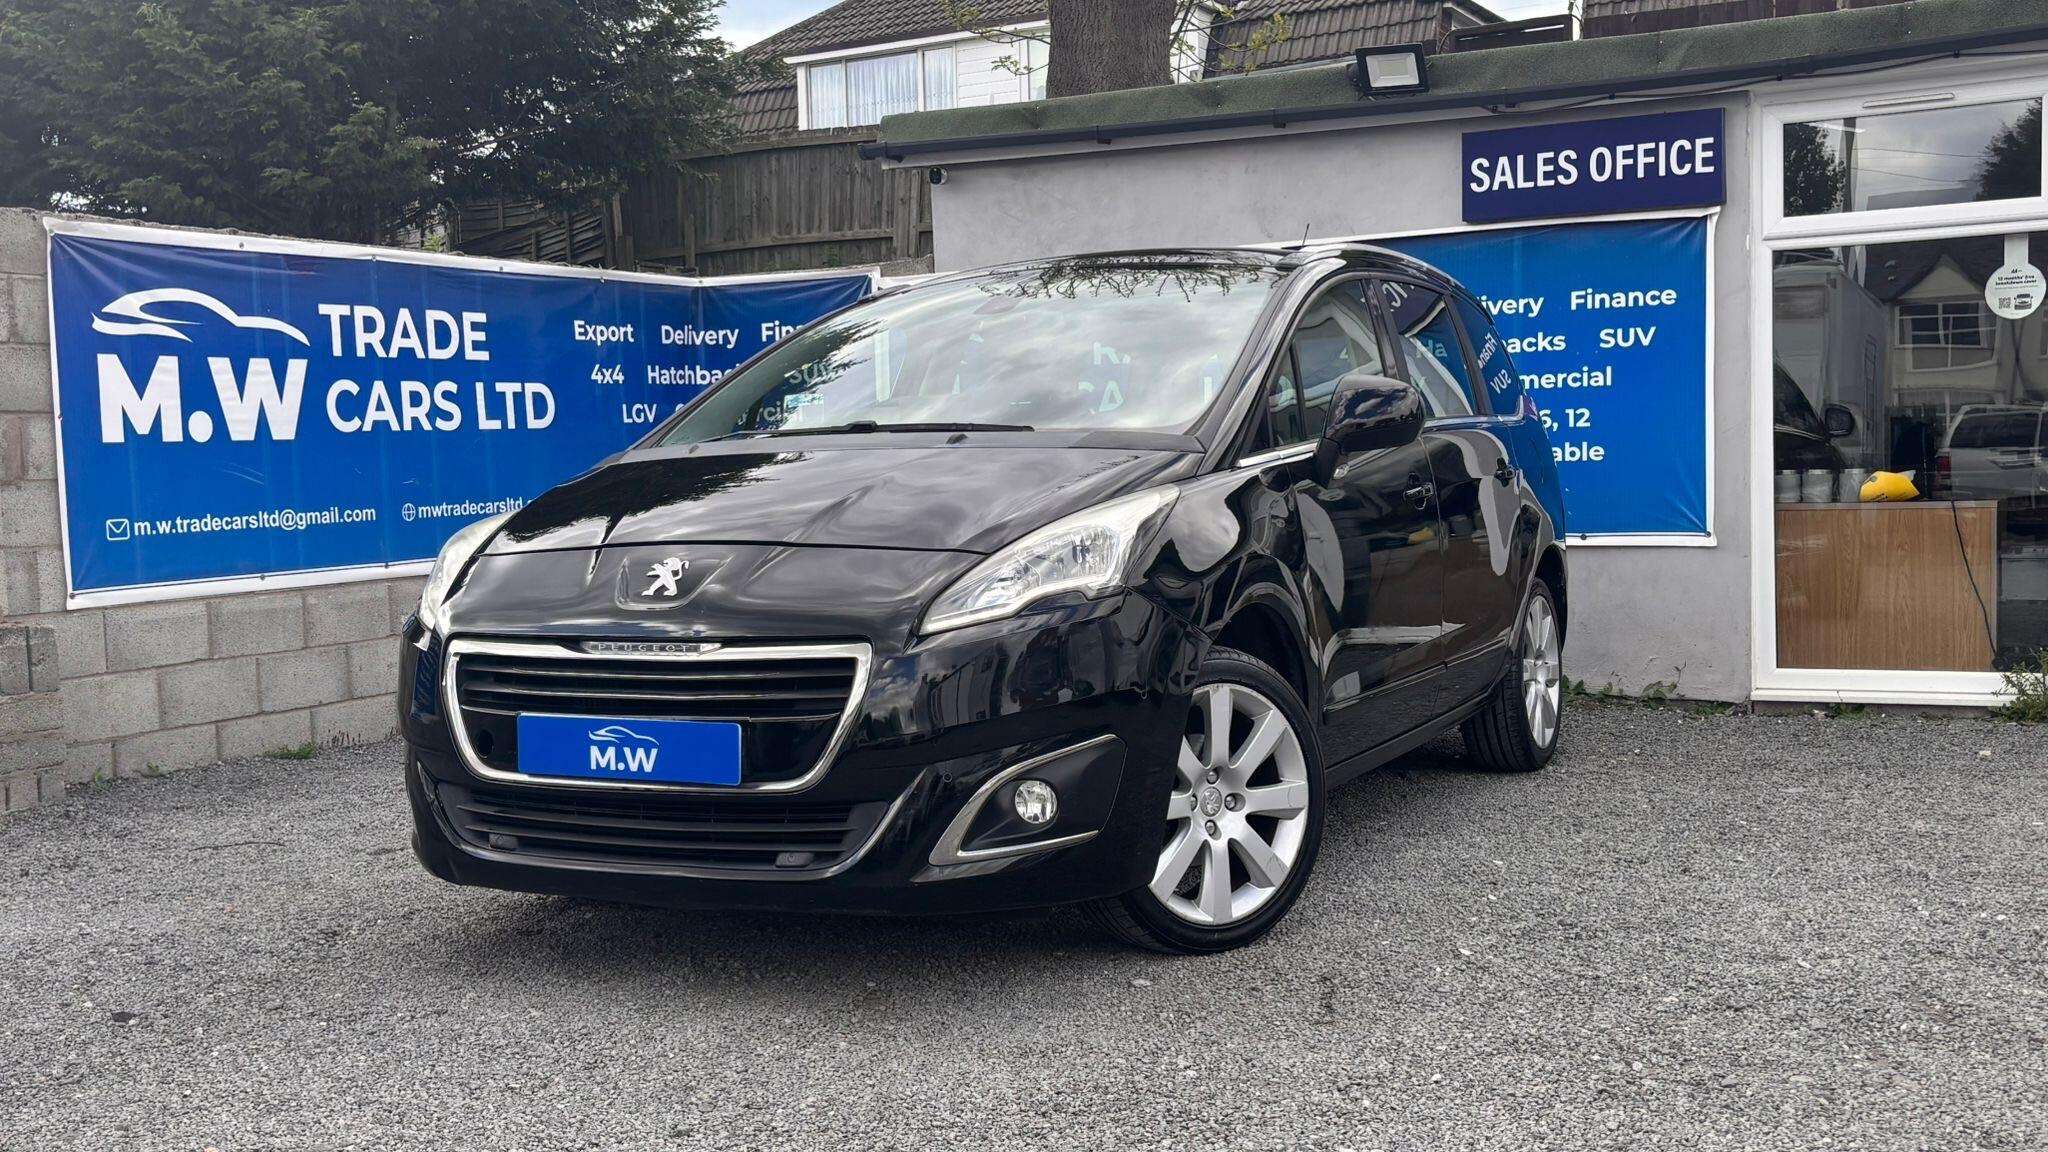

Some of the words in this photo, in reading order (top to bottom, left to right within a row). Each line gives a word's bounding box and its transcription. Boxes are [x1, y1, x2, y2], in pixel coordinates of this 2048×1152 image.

[1470, 148, 1578, 193] SALES
[1590, 137, 1715, 182] OFFICE
[1571, 288, 1678, 311] Finance
[318, 303, 490, 361] TRADE
[573, 320, 635, 346] Export
[661, 325, 739, 349] Delivery
[761, 320, 805, 342] Fin
[1501, 332, 1567, 353] acks
[1600, 326, 1656, 348] SUV
[591, 363, 625, 385] 4x4
[97, 353, 309, 443] M.W
[325, 380, 463, 433] CARS
[477, 381, 556, 431] LTD
[622, 403, 657, 424] LGV
[1565, 408, 1591, 428] 12
[133, 507, 377, 536] m.w.tradecarsltd@gmail.com
[599, 643, 691, 653] PEUGEOT
[589, 744, 658, 773] M.W
